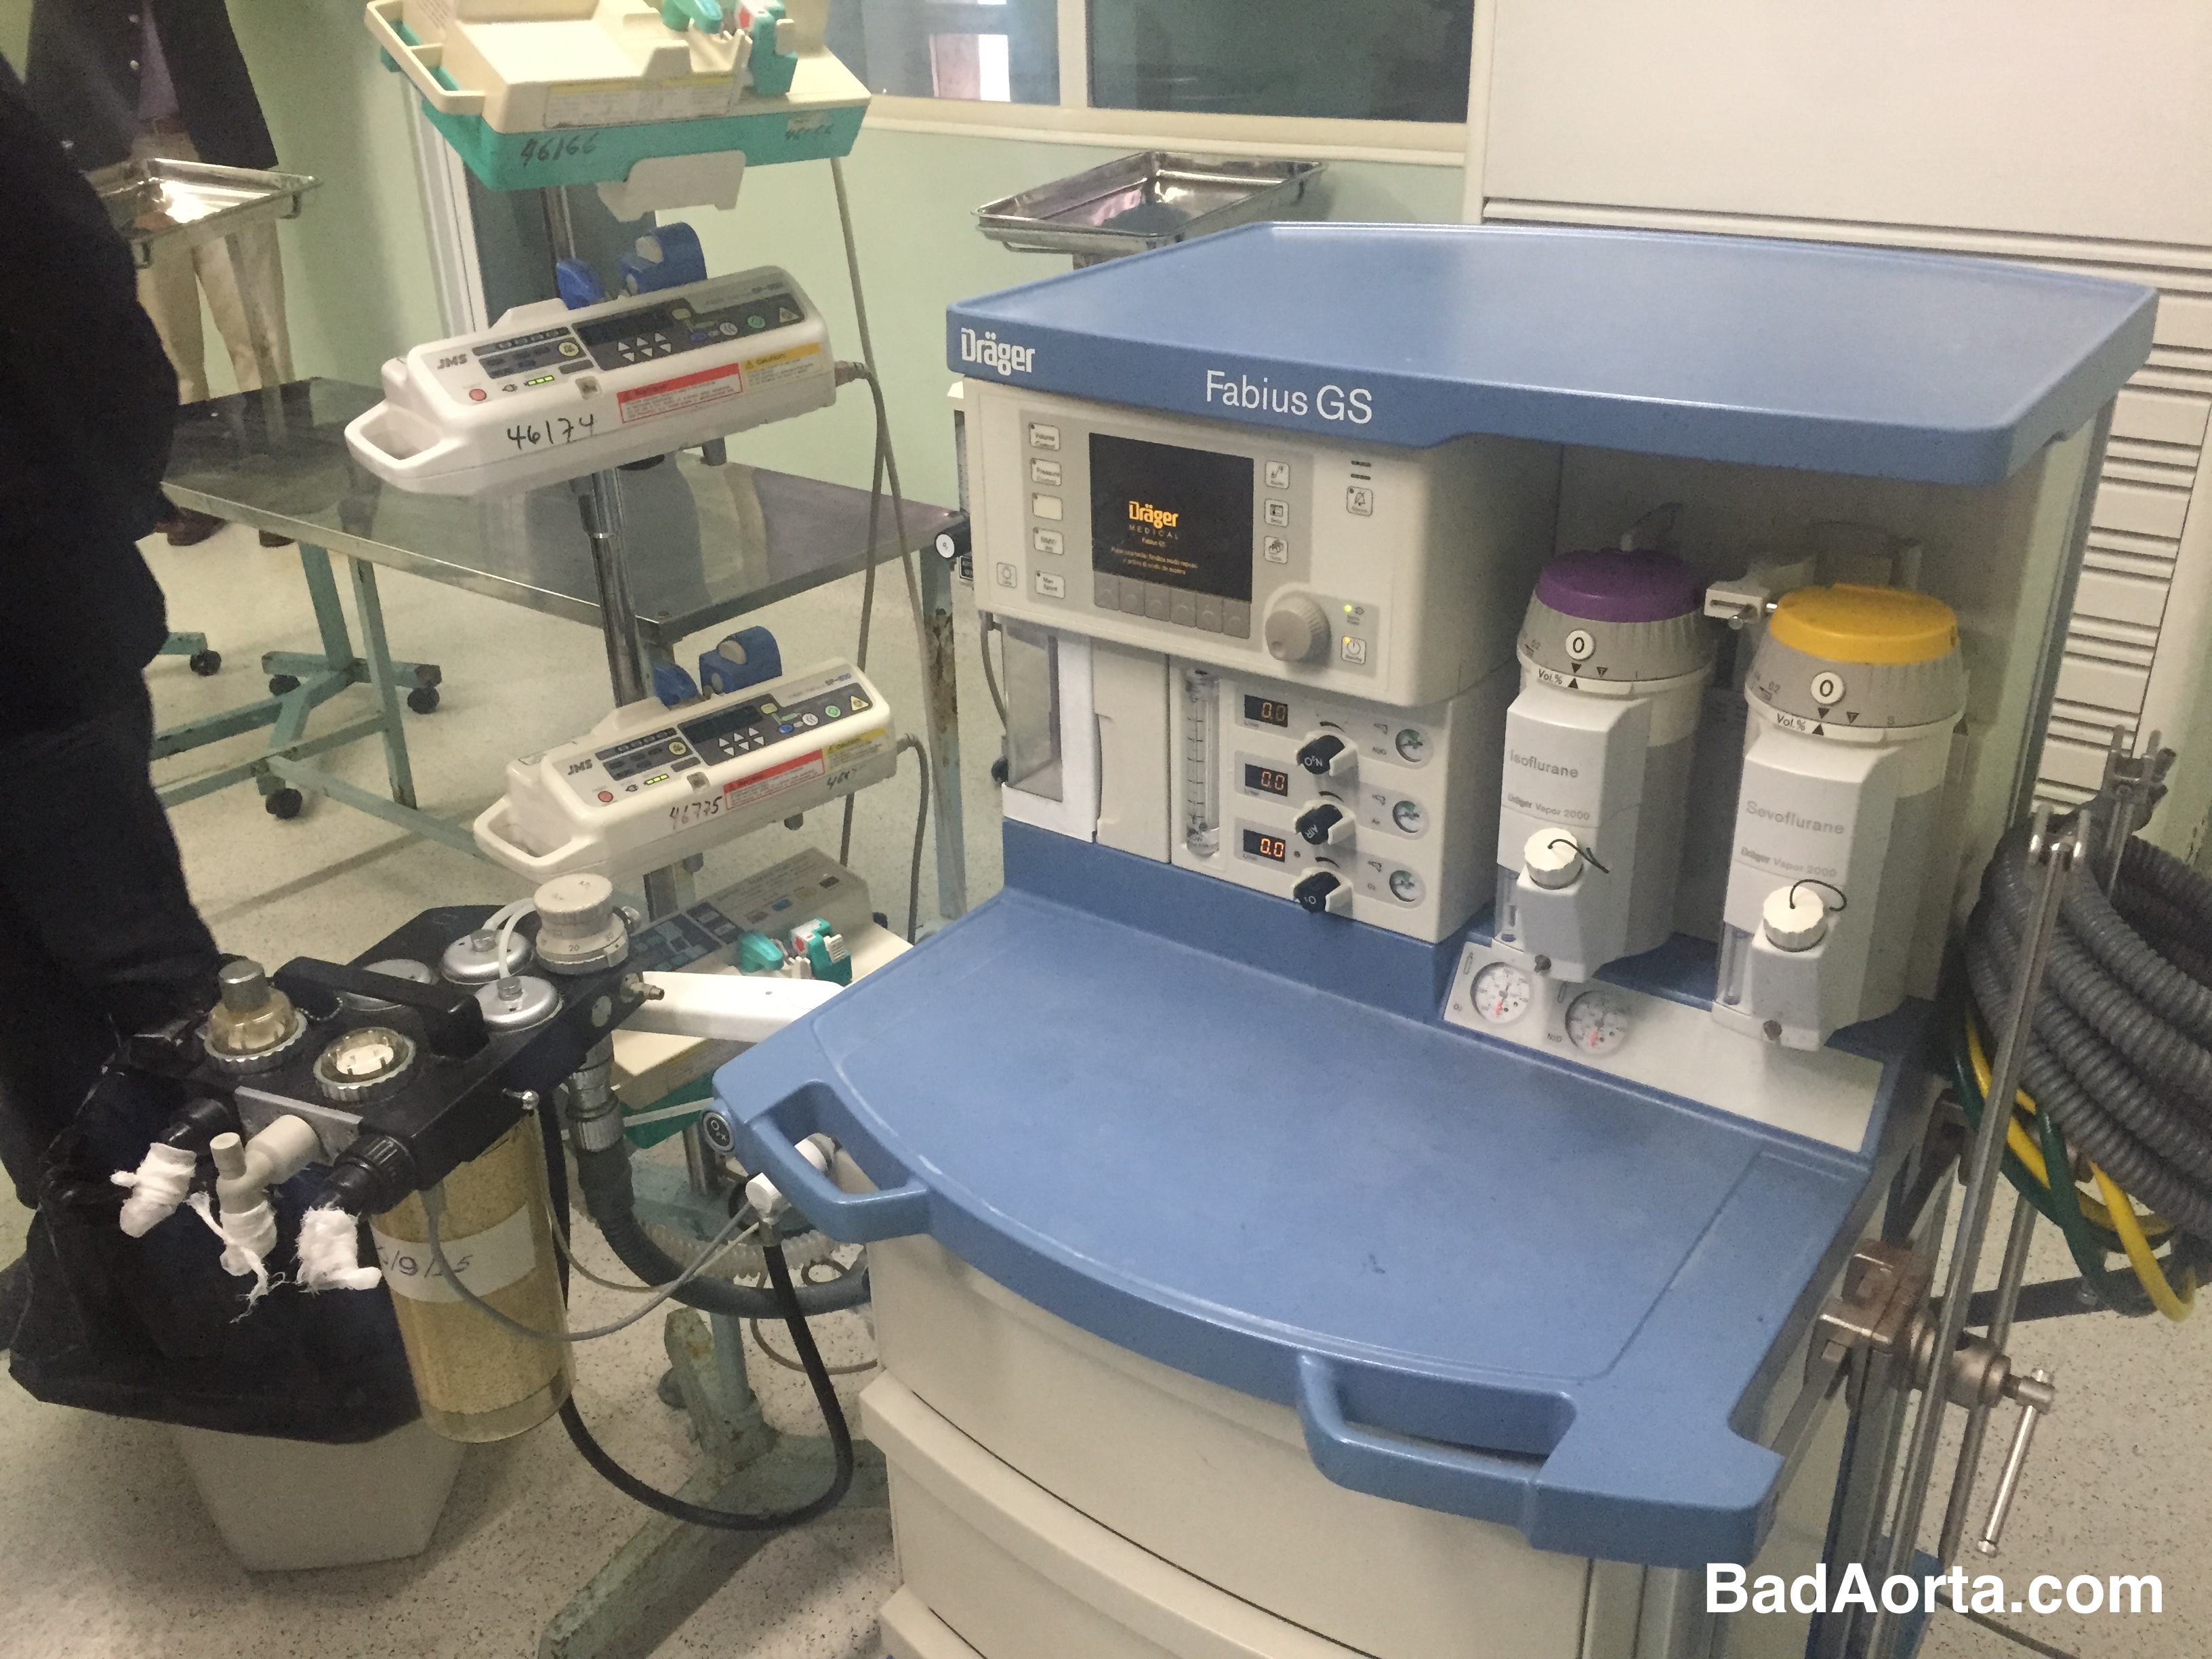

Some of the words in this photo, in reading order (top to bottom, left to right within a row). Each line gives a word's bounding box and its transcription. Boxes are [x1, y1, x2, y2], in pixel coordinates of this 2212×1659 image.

[960, 327, 1036, 376] Dräger
[437, 353, 468, 370] JMS
[1206, 369, 1309, 416] Fabius
[1316, 384, 1372, 424] GS
[506, 413, 595, 451] 46174
[1128, 500, 1179, 529] Dräger
[1128, 524, 1179, 541] MEDICAL
[1572, 636, 1585, 653] 0
[1819, 678, 1834, 697] 0
[567, 758, 593, 776] JMS
[1509, 748, 1578, 779] Isoflurane
[1563, 808, 1591, 821] 2000
[1746, 800, 1845, 835] Sevoflurane
[1260, 838, 1284, 858] 0.0
[1806, 865, 1837, 878] 2000
[569, 944, 580, 952] 20
